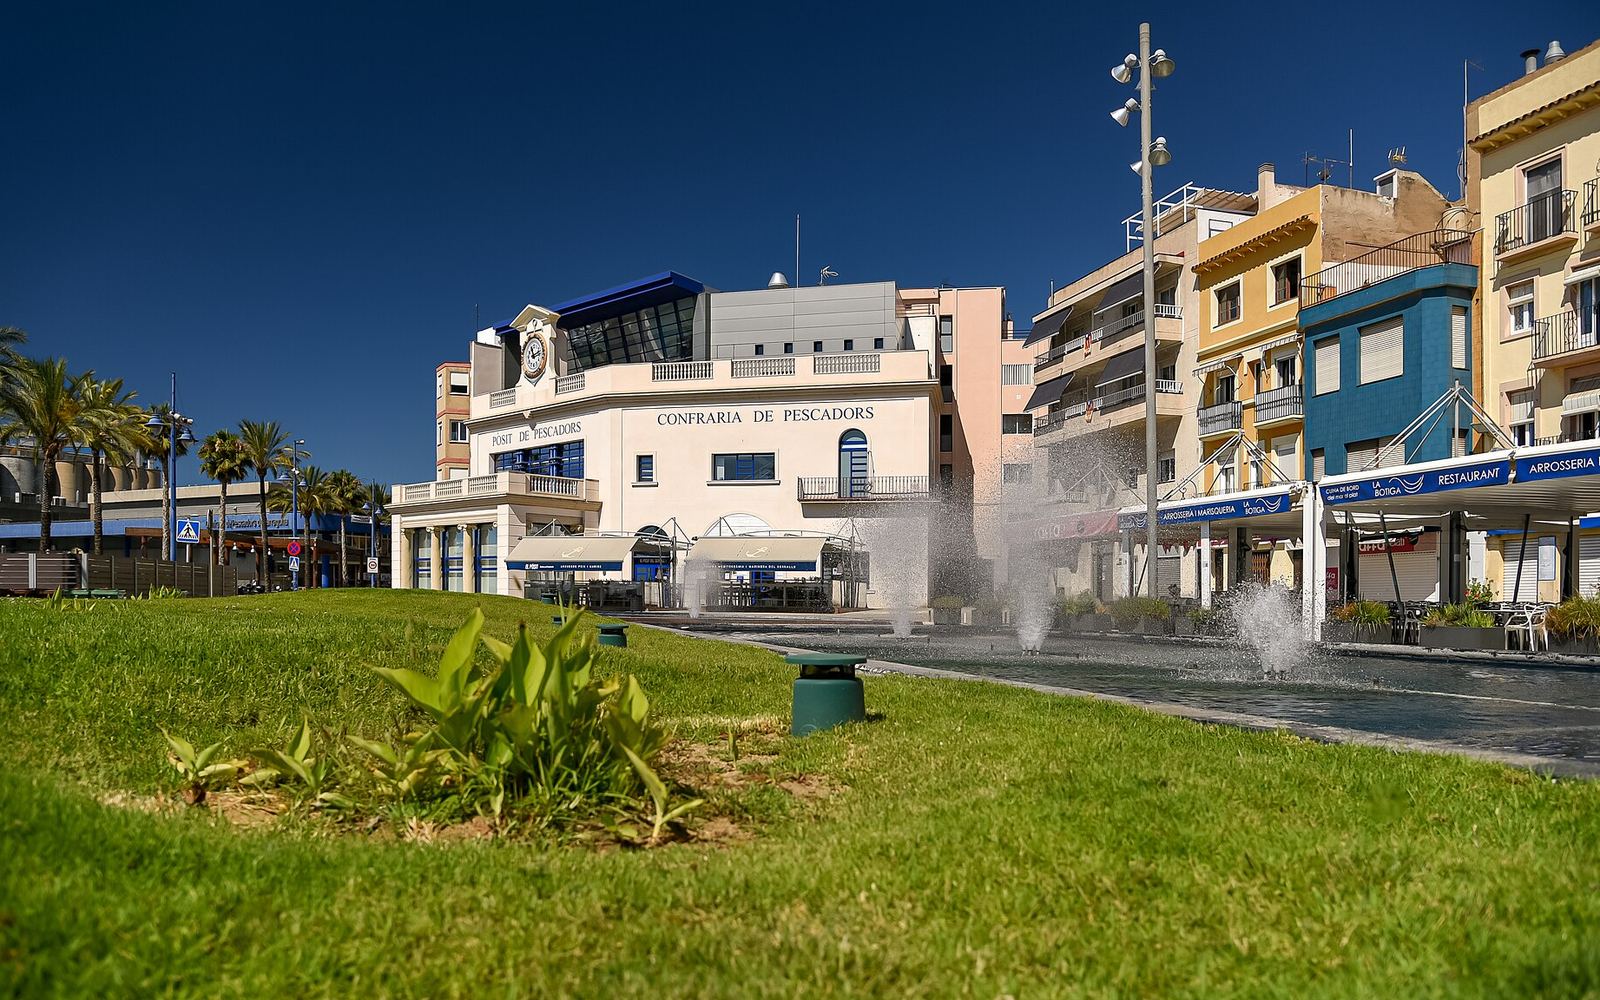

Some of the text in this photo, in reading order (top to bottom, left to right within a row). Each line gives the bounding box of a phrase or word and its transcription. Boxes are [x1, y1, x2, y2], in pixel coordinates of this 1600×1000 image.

[657, 406, 874, 426] CONFRARIA DE PESCADORS
[519, 430, 530, 442] DE
[533, 421, 582, 440] PESCADORS
[1529, 457, 1595, 474] ARROSSERIA
[1438, 467, 1500, 486] RESTAURANT
[1372, 481, 1381, 489] LA
[1374, 487, 1402, 497] BOTIGA
[1197, 505, 1236, 517] MARISQUERIA
[1245, 506, 1266, 515] BOTIGA
